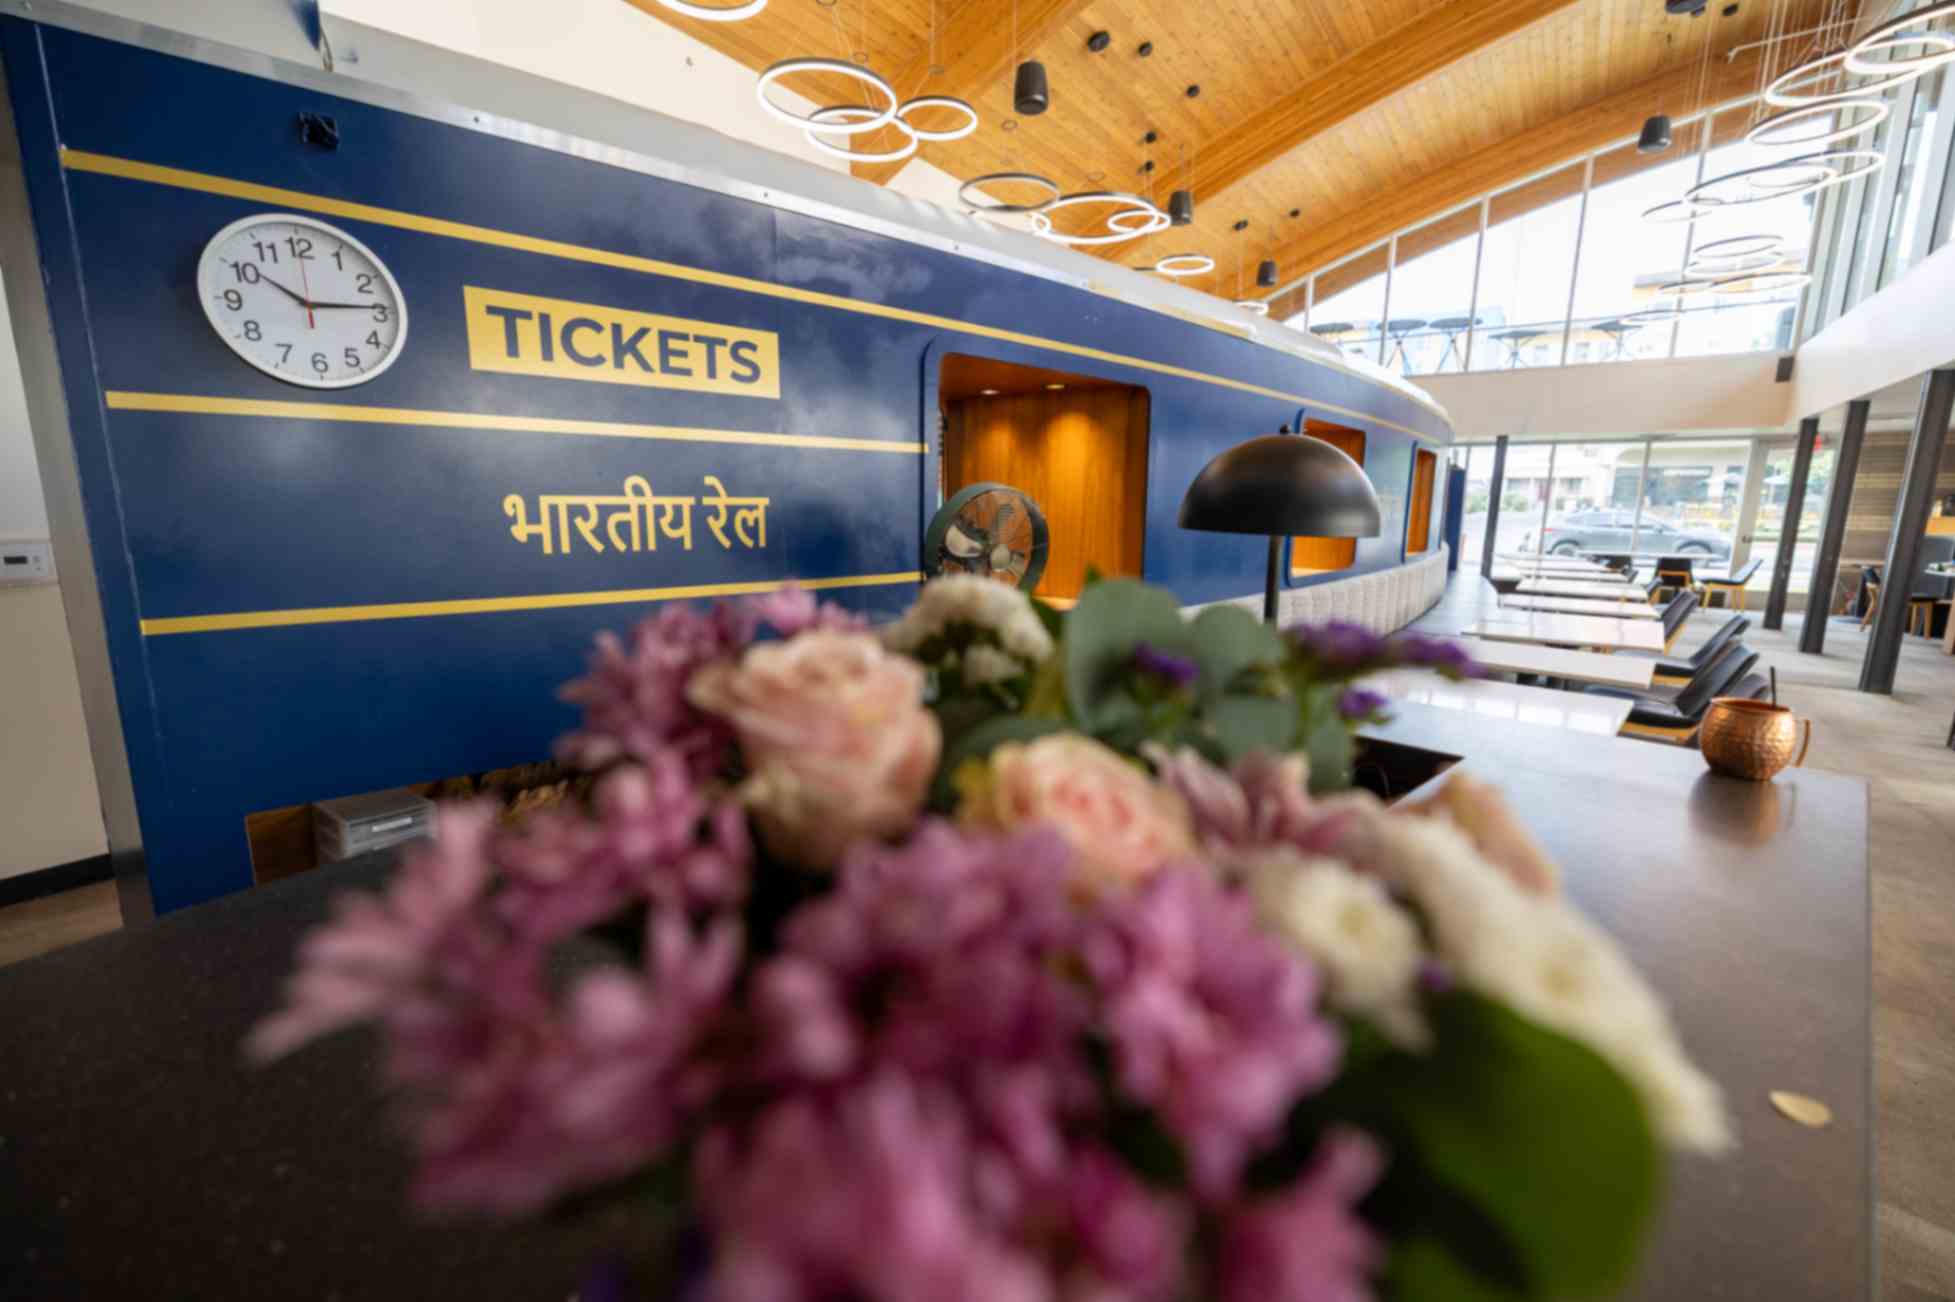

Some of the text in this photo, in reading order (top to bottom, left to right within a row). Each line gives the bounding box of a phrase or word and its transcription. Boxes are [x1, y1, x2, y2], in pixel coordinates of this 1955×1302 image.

[253, 241, 279, 264] 11
[285, 236, 316, 260] 12
[331, 250, 343, 271] 1
[230, 261, 261, 285] 10
[355, 273, 374, 294] 2
[223, 289, 243, 311] 9
[372, 303, 389, 323] 3
[243, 320, 262, 342] 8
[365, 331, 381, 350] 4
[274, 343, 293, 364] 7
[485, 304, 761, 384] TICKETS
[311, 353, 329, 373] 6
[344, 347, 361, 368] 5
[503, 474, 770, 554] भारतीय रेल
